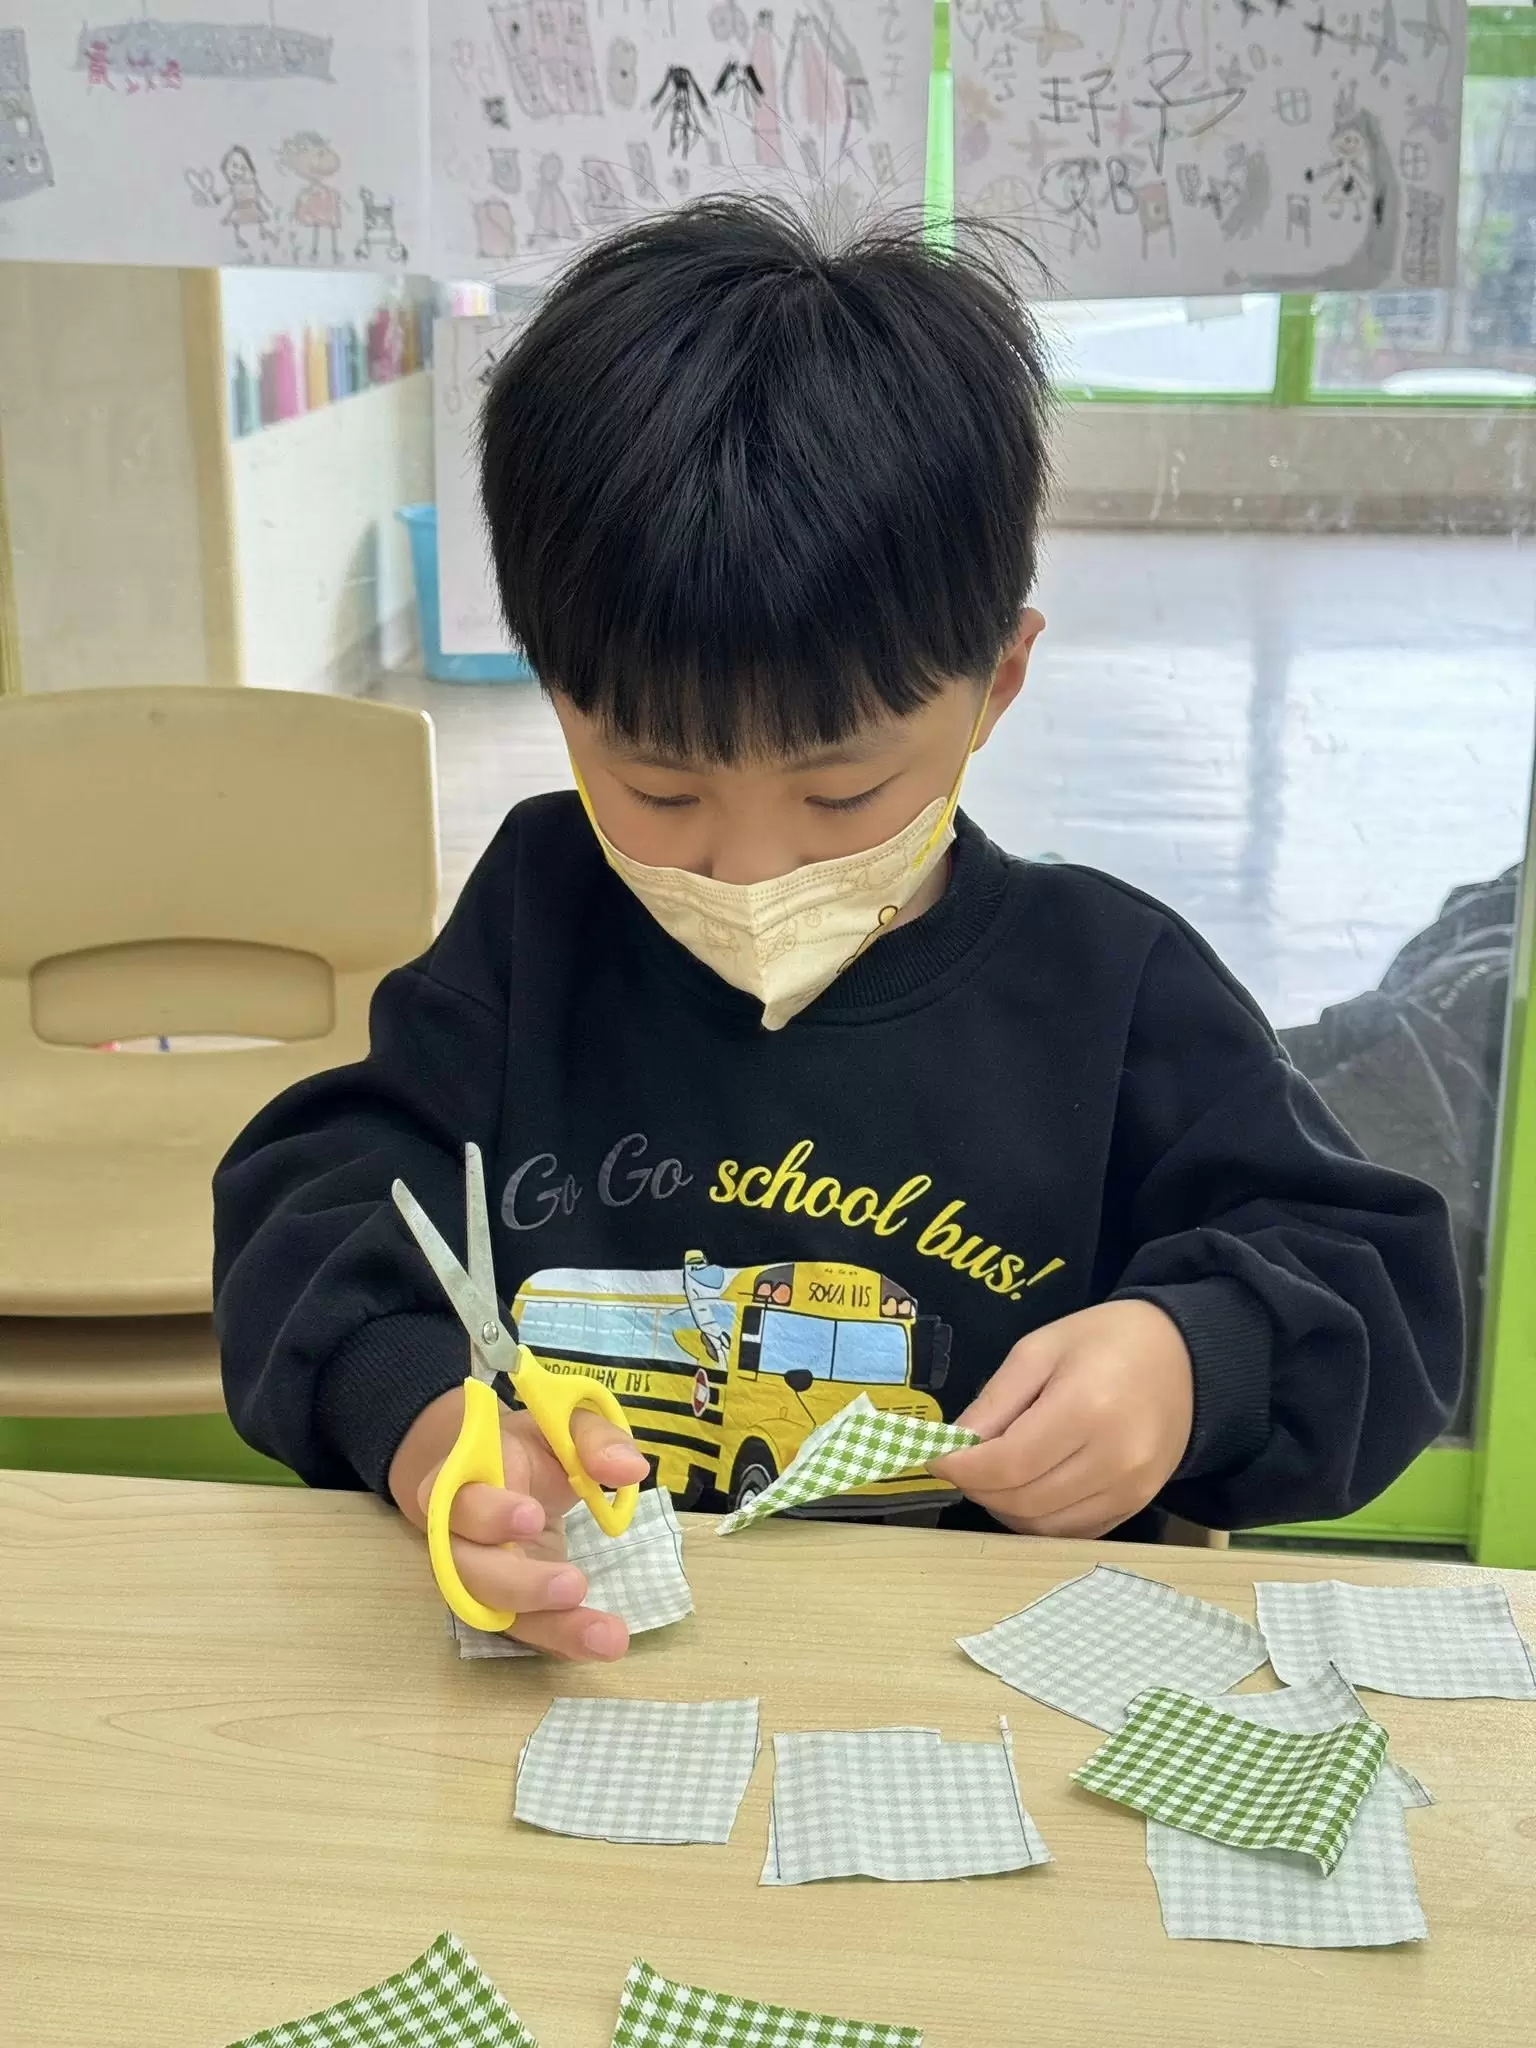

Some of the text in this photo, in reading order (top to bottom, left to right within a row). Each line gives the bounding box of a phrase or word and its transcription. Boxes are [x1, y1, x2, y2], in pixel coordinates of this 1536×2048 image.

[500, 1132, 1066, 1301] Go Go school bus!
